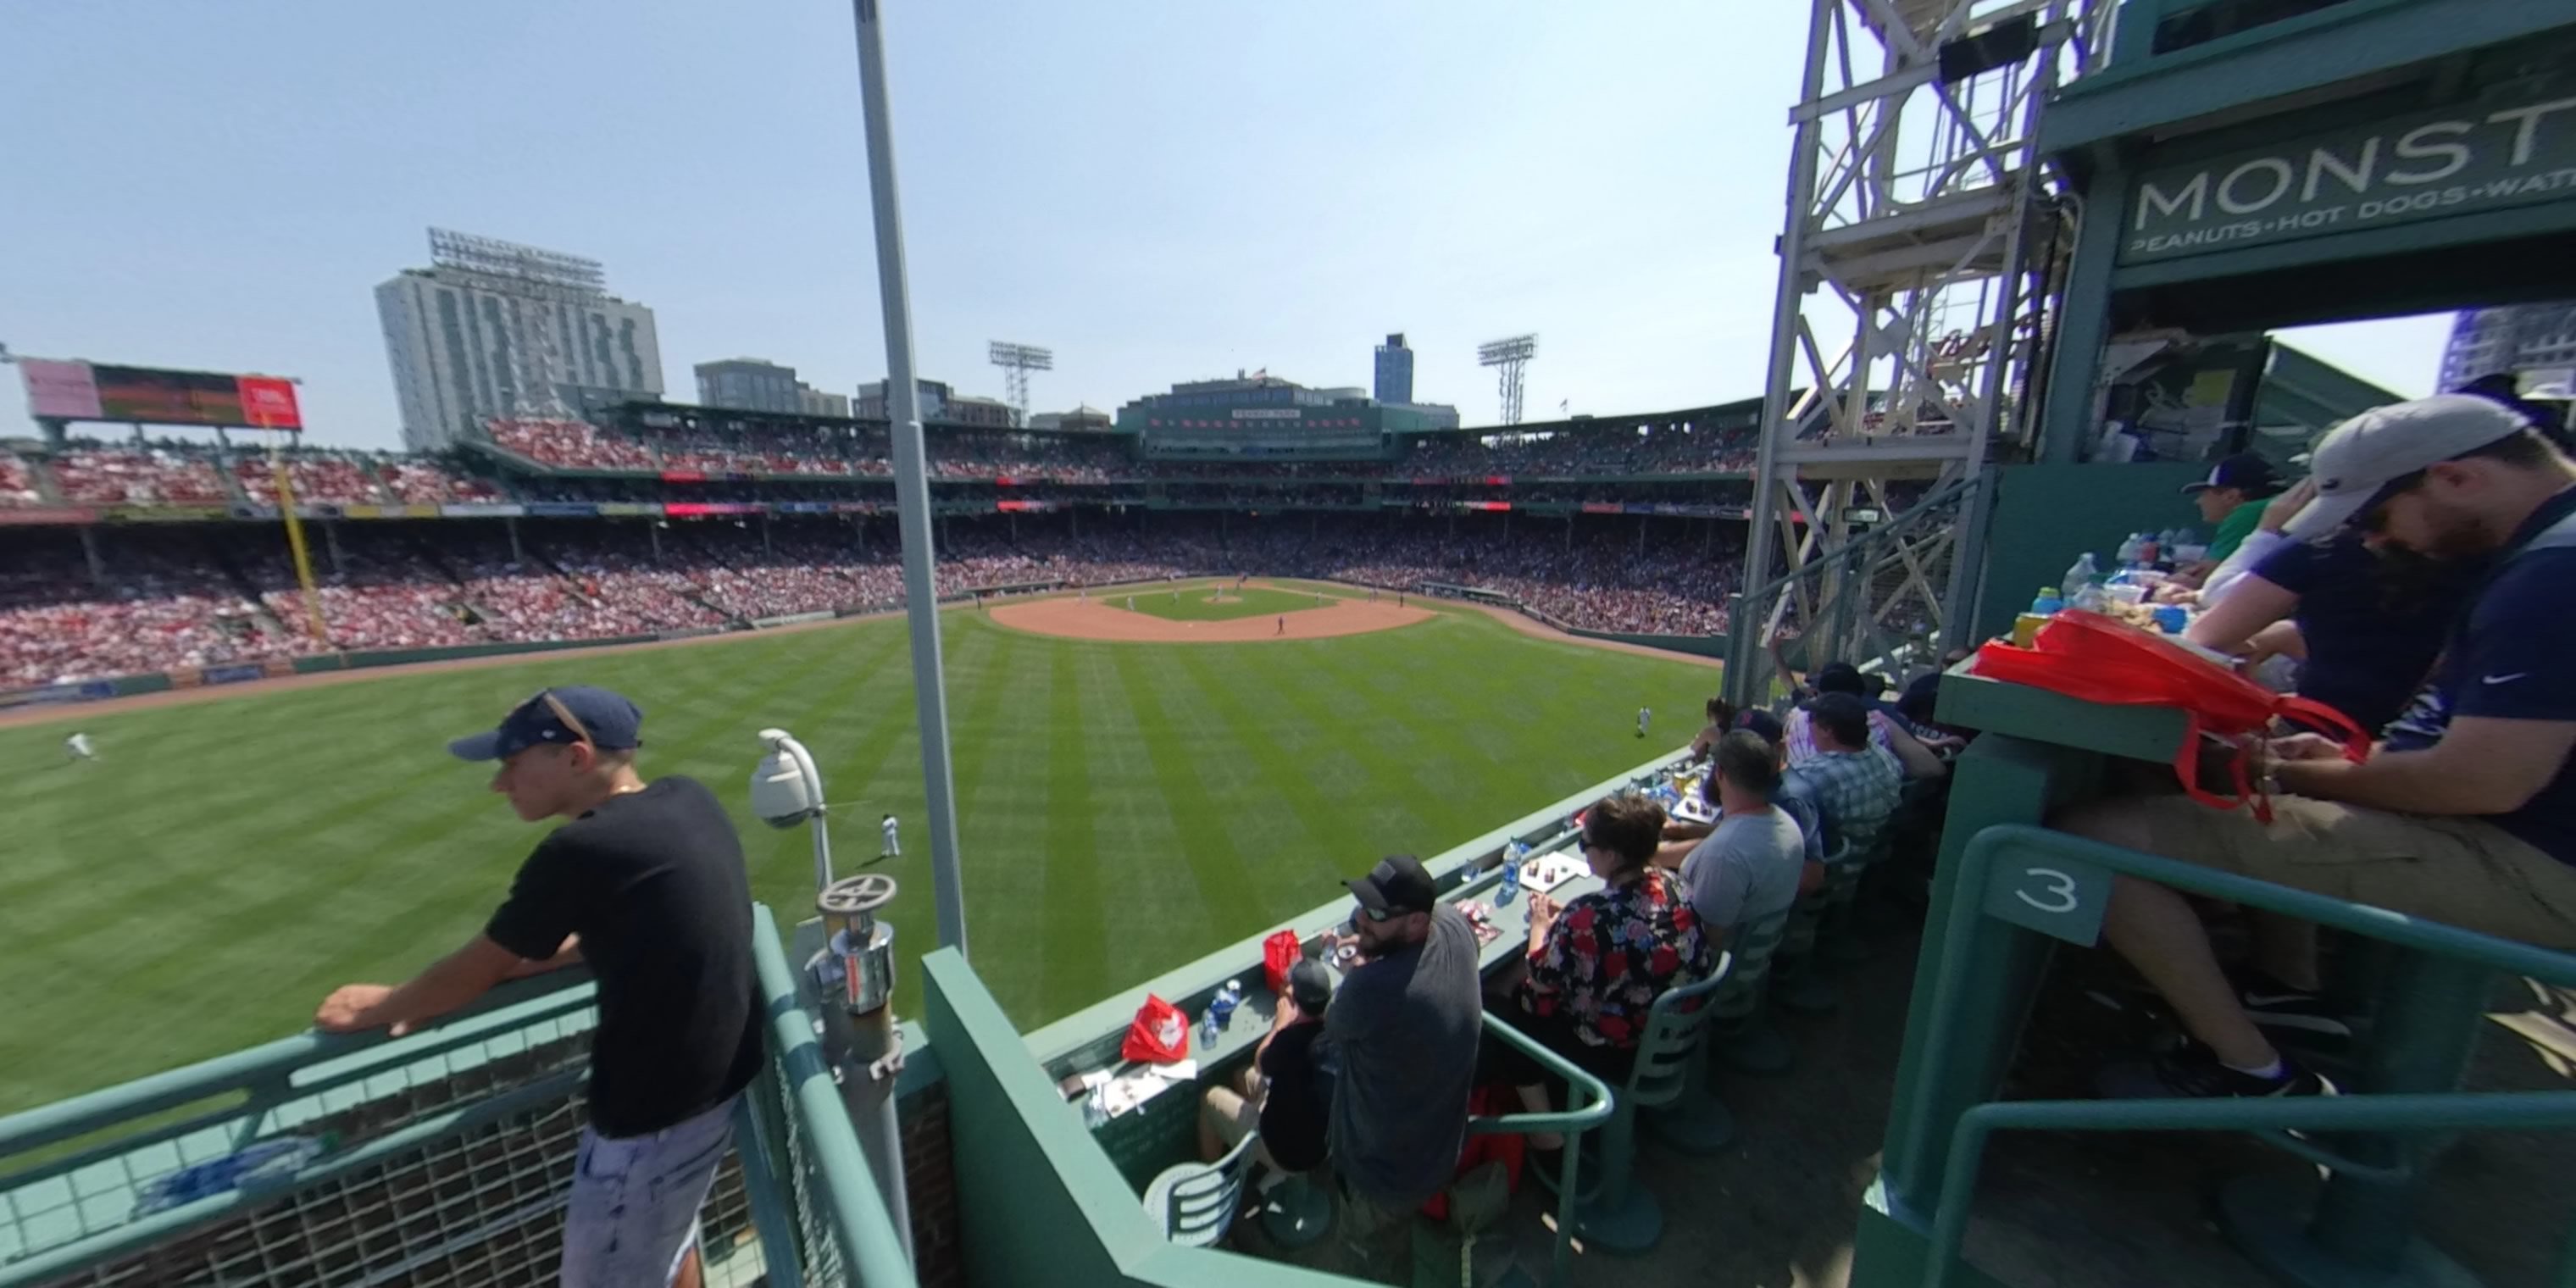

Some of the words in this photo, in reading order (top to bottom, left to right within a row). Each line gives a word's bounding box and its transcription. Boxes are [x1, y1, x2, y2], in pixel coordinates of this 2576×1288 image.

[2135, 97, 2576, 230] MONST
[2130, 219, 2261, 253] PEANUTS
[2277, 205, 2346, 232] HOT
[2358, 186, 2467, 219] DOGS
[2014, 867, 2078, 913] 3
